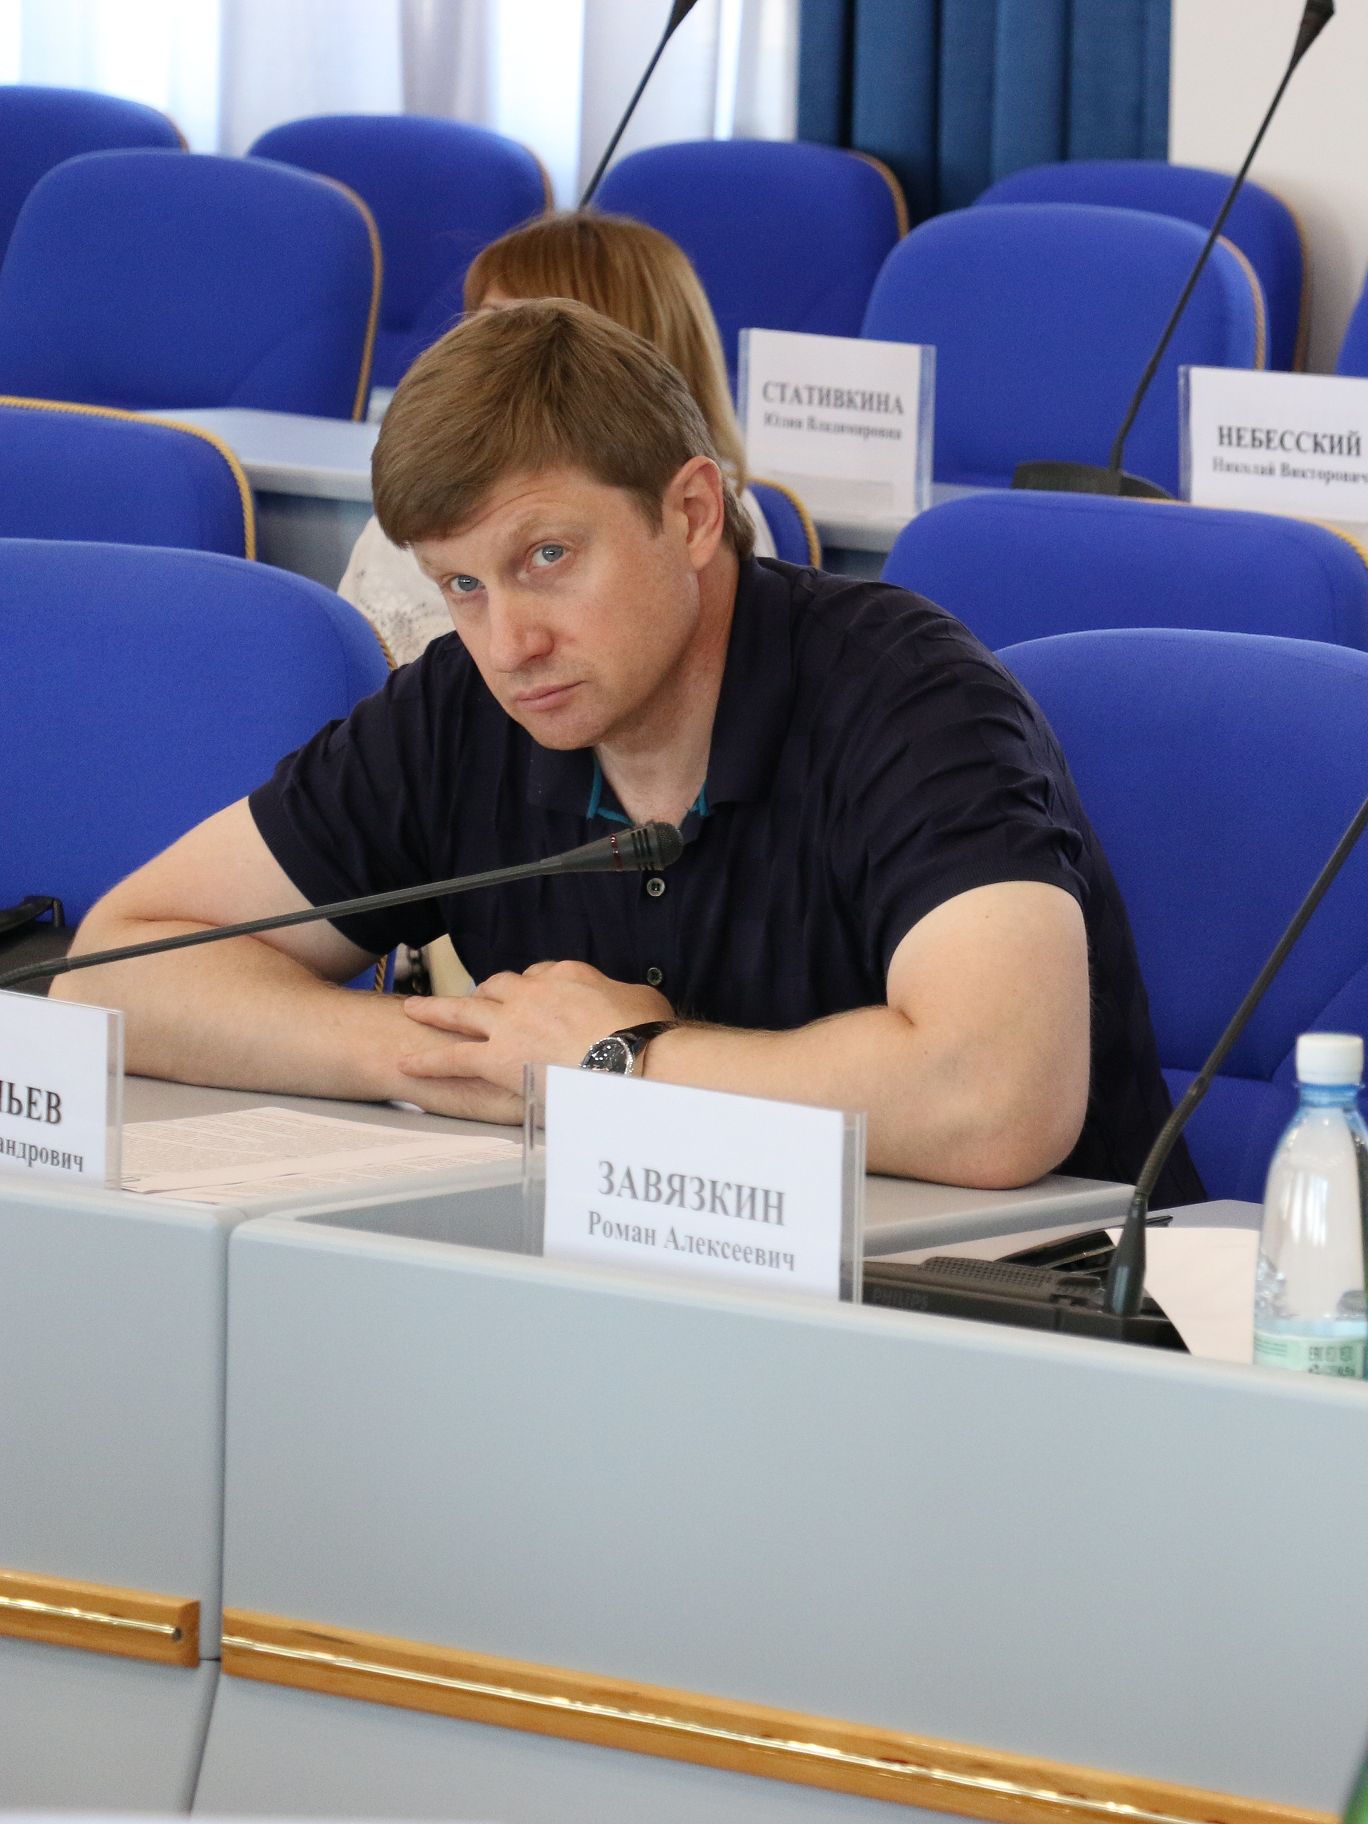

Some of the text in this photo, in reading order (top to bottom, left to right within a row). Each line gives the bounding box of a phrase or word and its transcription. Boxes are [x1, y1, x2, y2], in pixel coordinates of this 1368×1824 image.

[762, 380, 904, 415] СТАТИВКИНА
[1218, 425, 1361, 456] НЕБЕССКИЙ
[1212, 456, 1368, 485] Николай Викторович
[598, 1160, 786, 1226] ЗАВЯЗКИН
[588, 1210, 795, 1272] Роман Алексеевич
